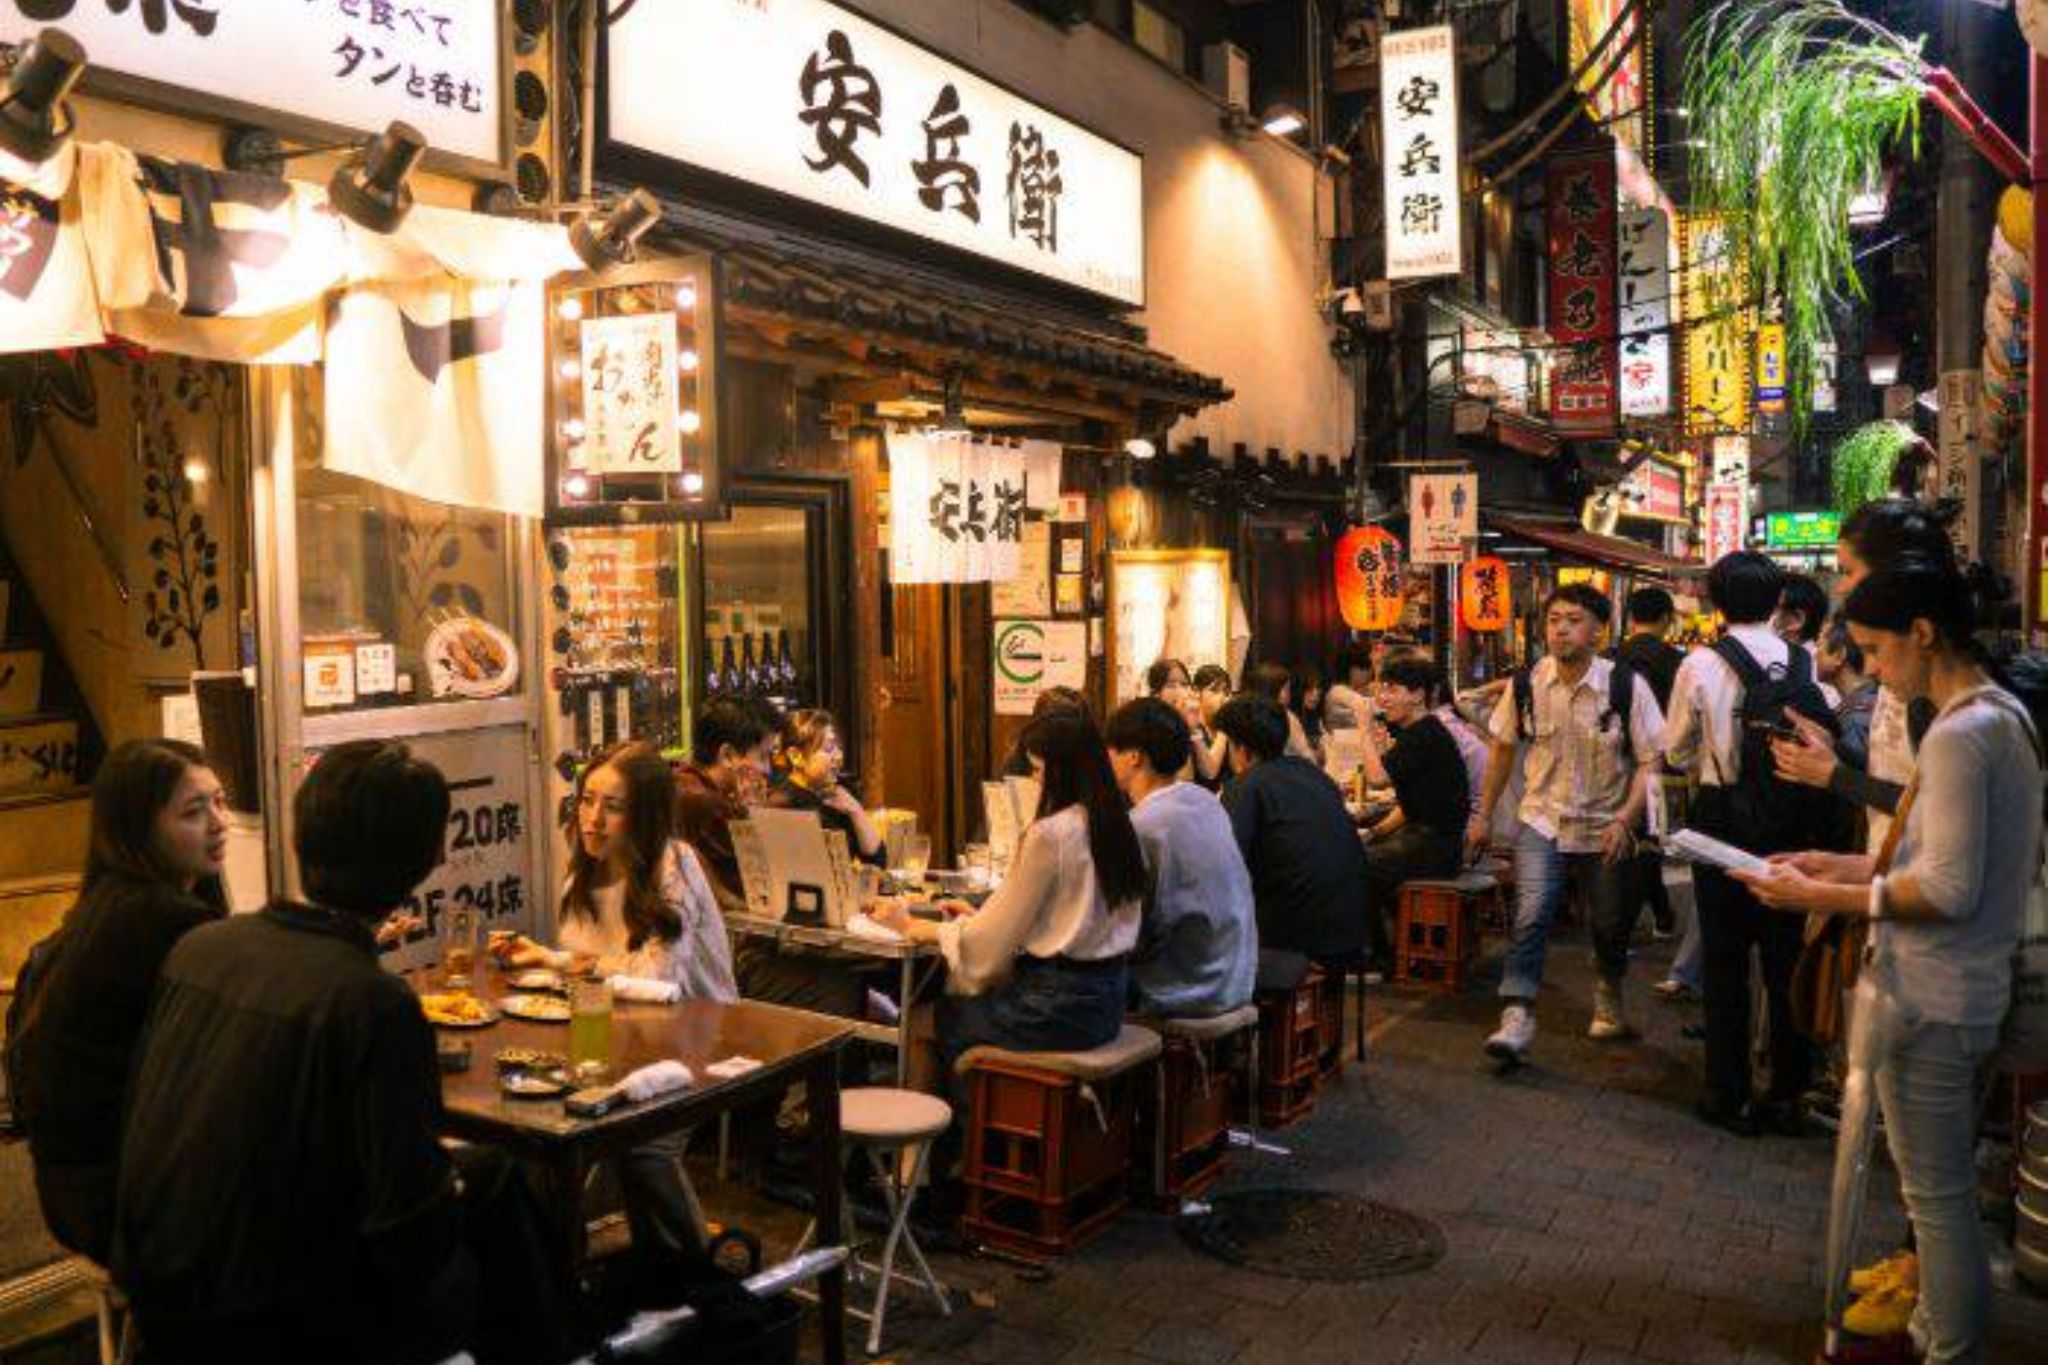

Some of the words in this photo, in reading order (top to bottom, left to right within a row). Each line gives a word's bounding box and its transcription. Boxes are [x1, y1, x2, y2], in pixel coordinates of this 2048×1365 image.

[333, 36, 482, 113] タンと呑む
[798, 30, 1063, 254] 安兵衛
[1396, 75, 1443, 235] 安兵衛
